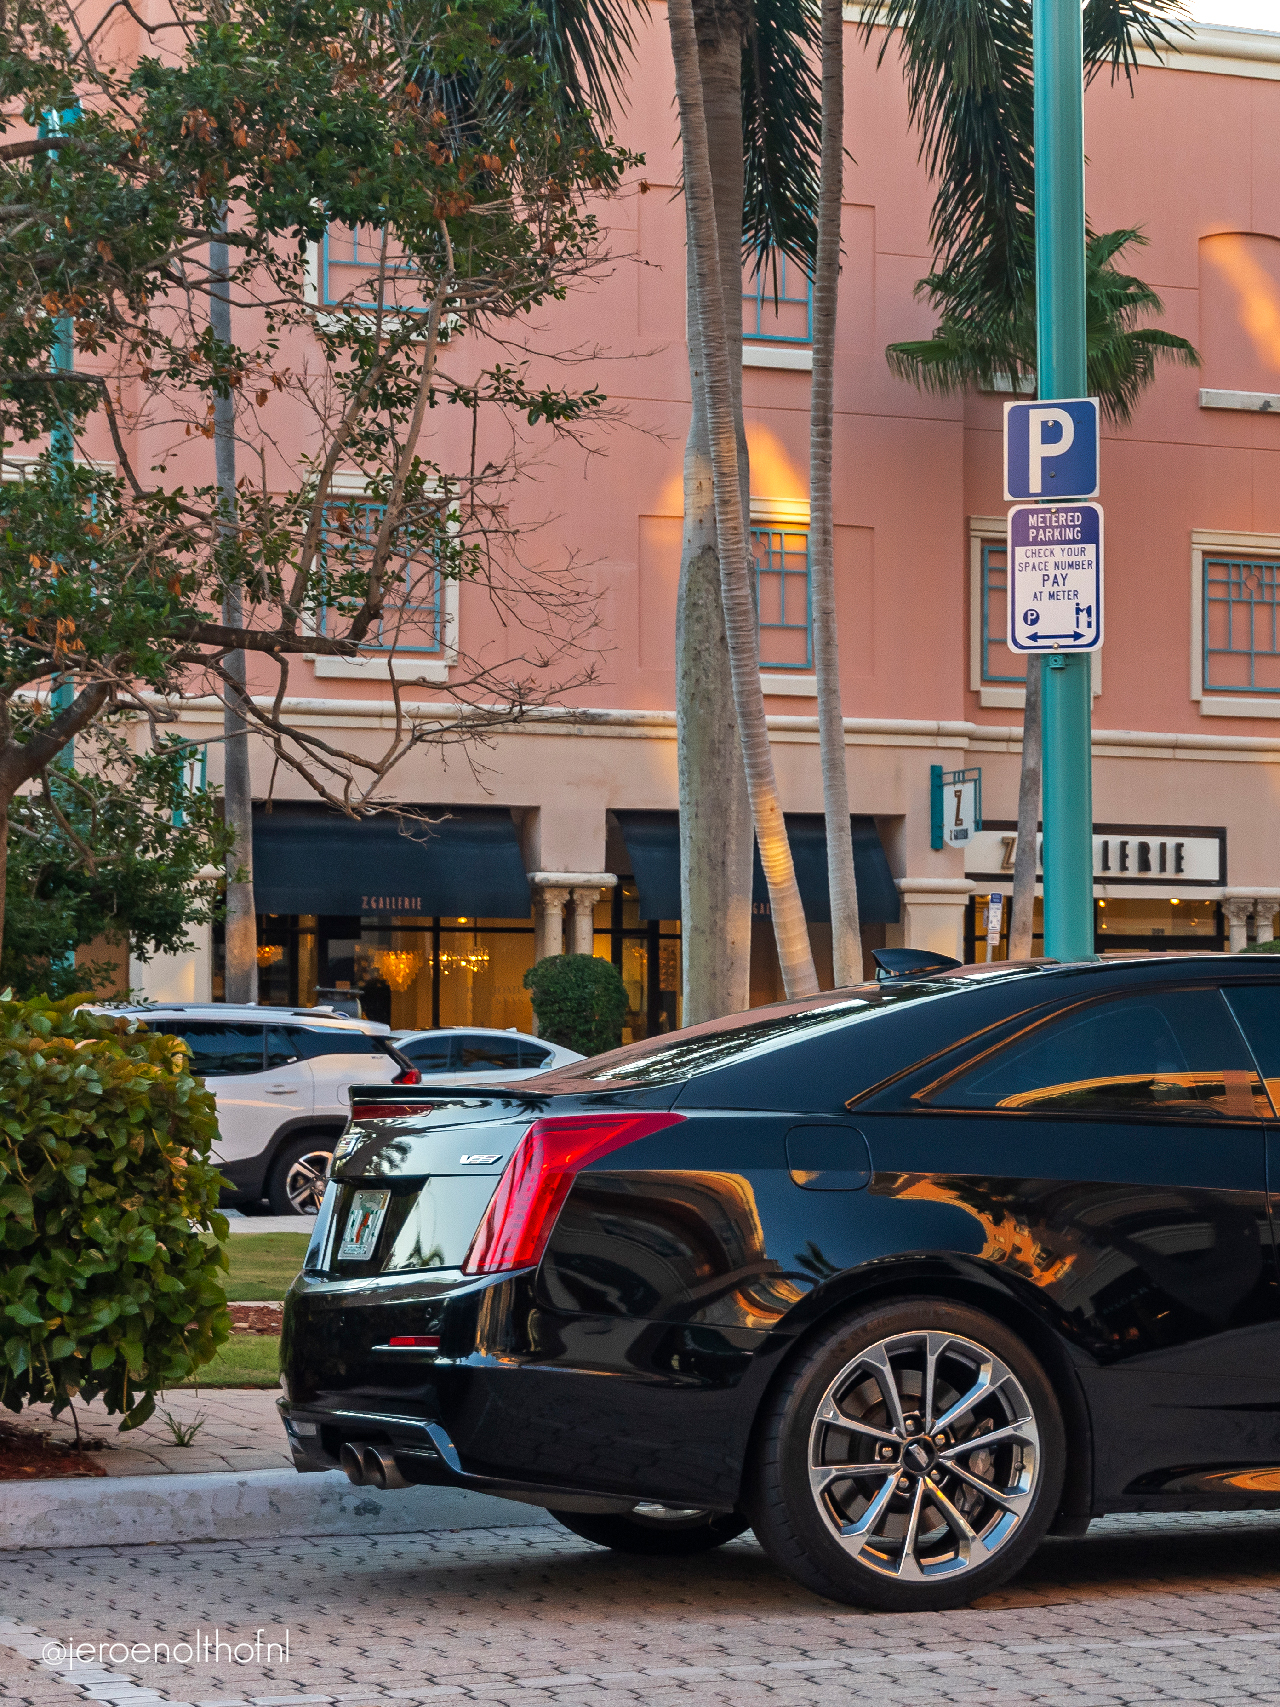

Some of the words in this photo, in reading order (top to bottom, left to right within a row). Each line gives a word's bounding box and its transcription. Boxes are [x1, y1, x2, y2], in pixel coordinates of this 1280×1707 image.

[1029, 407, 1075, 494] P
[1028, 512, 1082, 527] METERED
[1029, 527, 1082, 542] PARKING
[1024, 548, 1056, 558] CHECK
[1060, 547, 1086, 557] YOUR
[1018, 561, 1050, 572] SPACE
[1054, 560, 1093, 571] NUMBER
[1042, 573, 1068, 587] PAY
[1032, 591, 1043, 601] AT
[1048, 590, 1079, 601] METER
[953, 789, 963, 827] Z
[1000, 836, 1016, 870] Z
